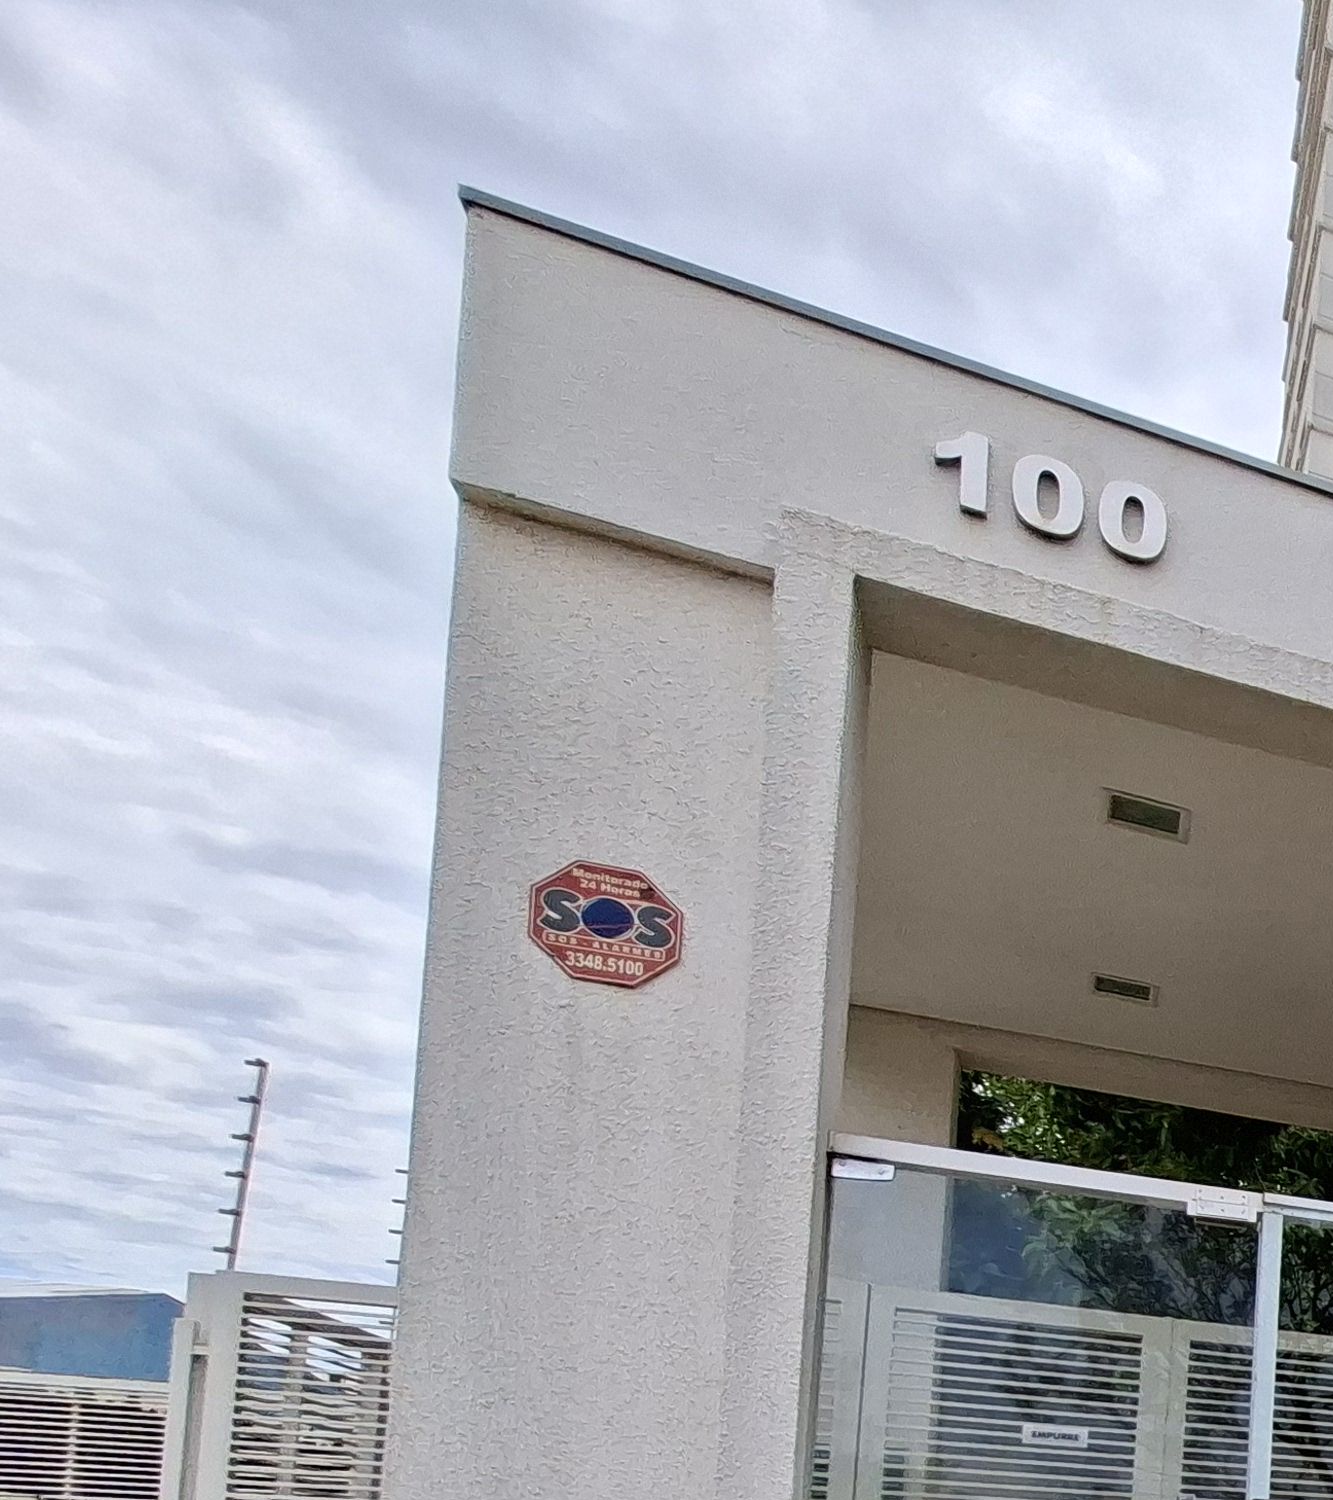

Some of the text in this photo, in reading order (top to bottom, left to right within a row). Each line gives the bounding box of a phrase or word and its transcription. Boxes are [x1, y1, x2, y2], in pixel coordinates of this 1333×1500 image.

[935, 431, 1168, 563] 100
[572, 867, 649, 890] Monitorado
[579, 878, 641, 898] 24 Horas
[538, 887, 676, 950] SOS
[592, 940, 661, 960] ALARMES
[564, 950, 644, 976] 3348.5100
